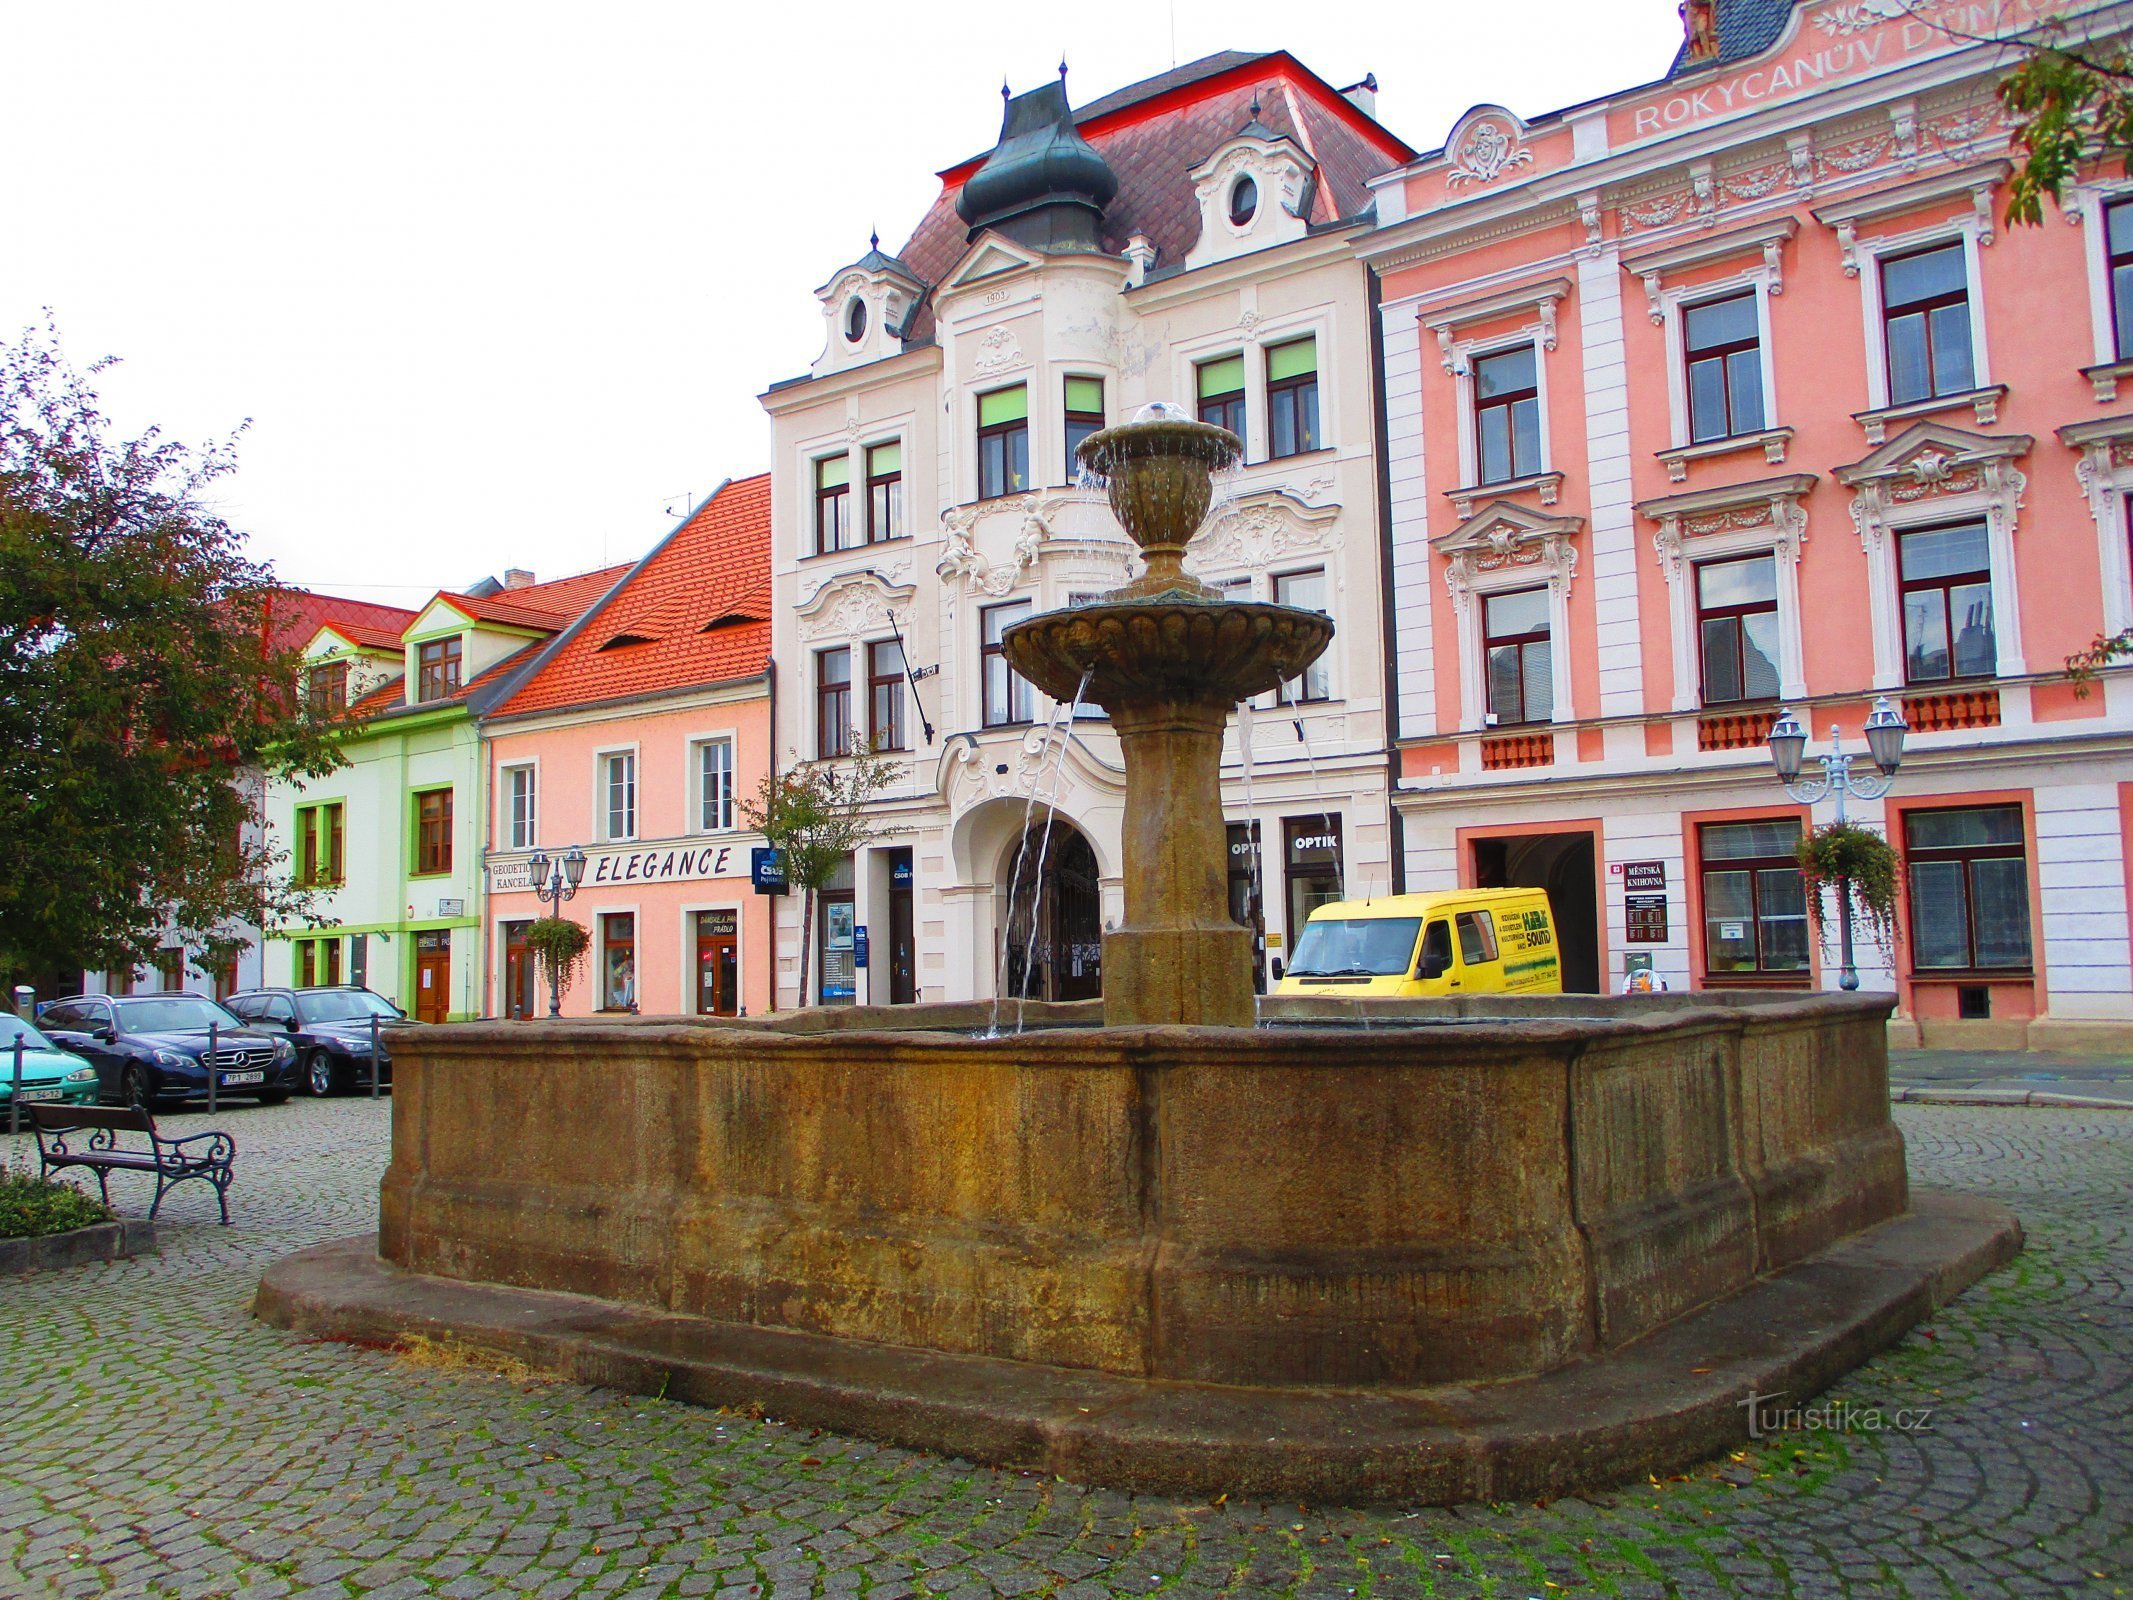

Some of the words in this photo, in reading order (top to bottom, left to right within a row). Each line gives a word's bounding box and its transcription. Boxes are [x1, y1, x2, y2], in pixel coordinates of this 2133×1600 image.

[1634, 32, 1884, 136] ROKYCANŮV
[987, 291, 1005, 304] 1903
[1231, 843, 1260, 855] OPTI
[1295, 836, 1337, 849] OPTIK
[596, 847, 732, 882] ELEGANCE
[1628, 864, 1661, 876] MĚSTSKÁ
[1627, 877, 1663, 888] KNIHOVNA
[1526, 930, 1550, 947] SOUND
